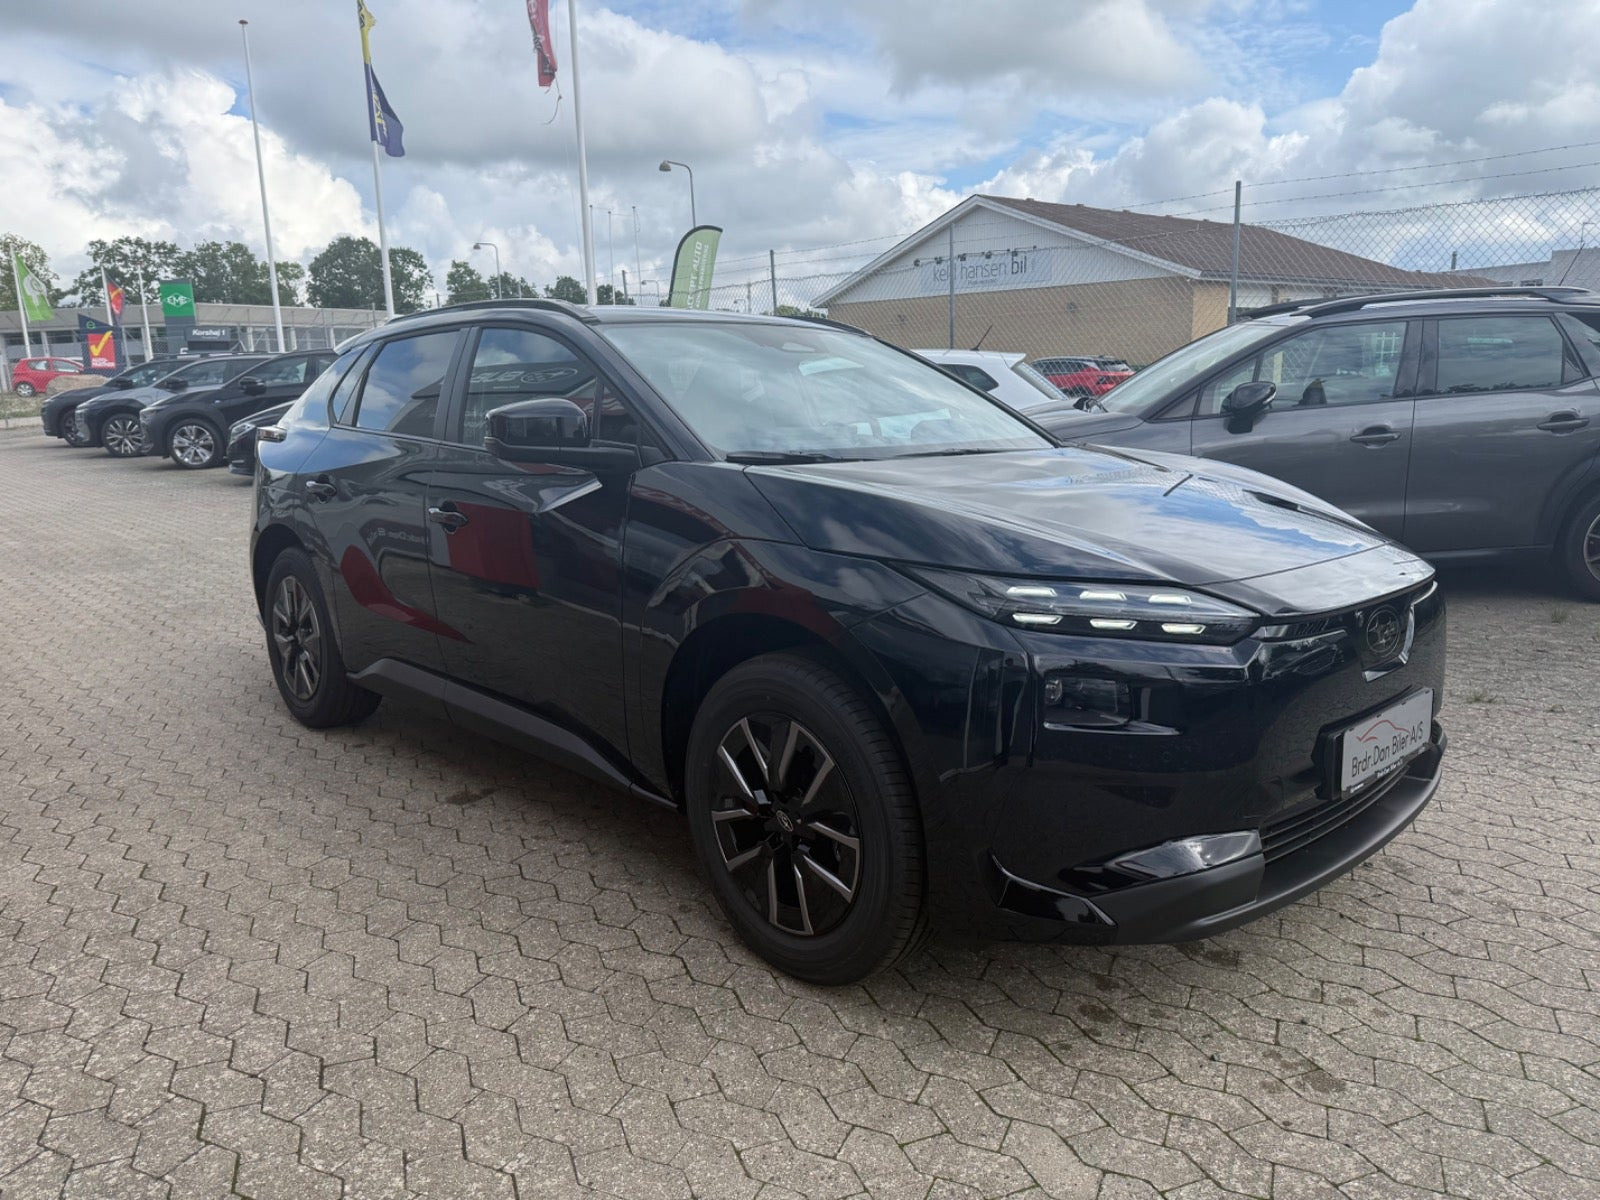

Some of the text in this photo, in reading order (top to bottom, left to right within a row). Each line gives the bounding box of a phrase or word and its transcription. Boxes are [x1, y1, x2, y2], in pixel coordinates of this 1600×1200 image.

[960, 261, 1007, 280] hansen
[1011, 255, 1027, 275] bil
[1392, 732, 1409, 756] Biler
[1410, 720, 1424, 745] A/S
